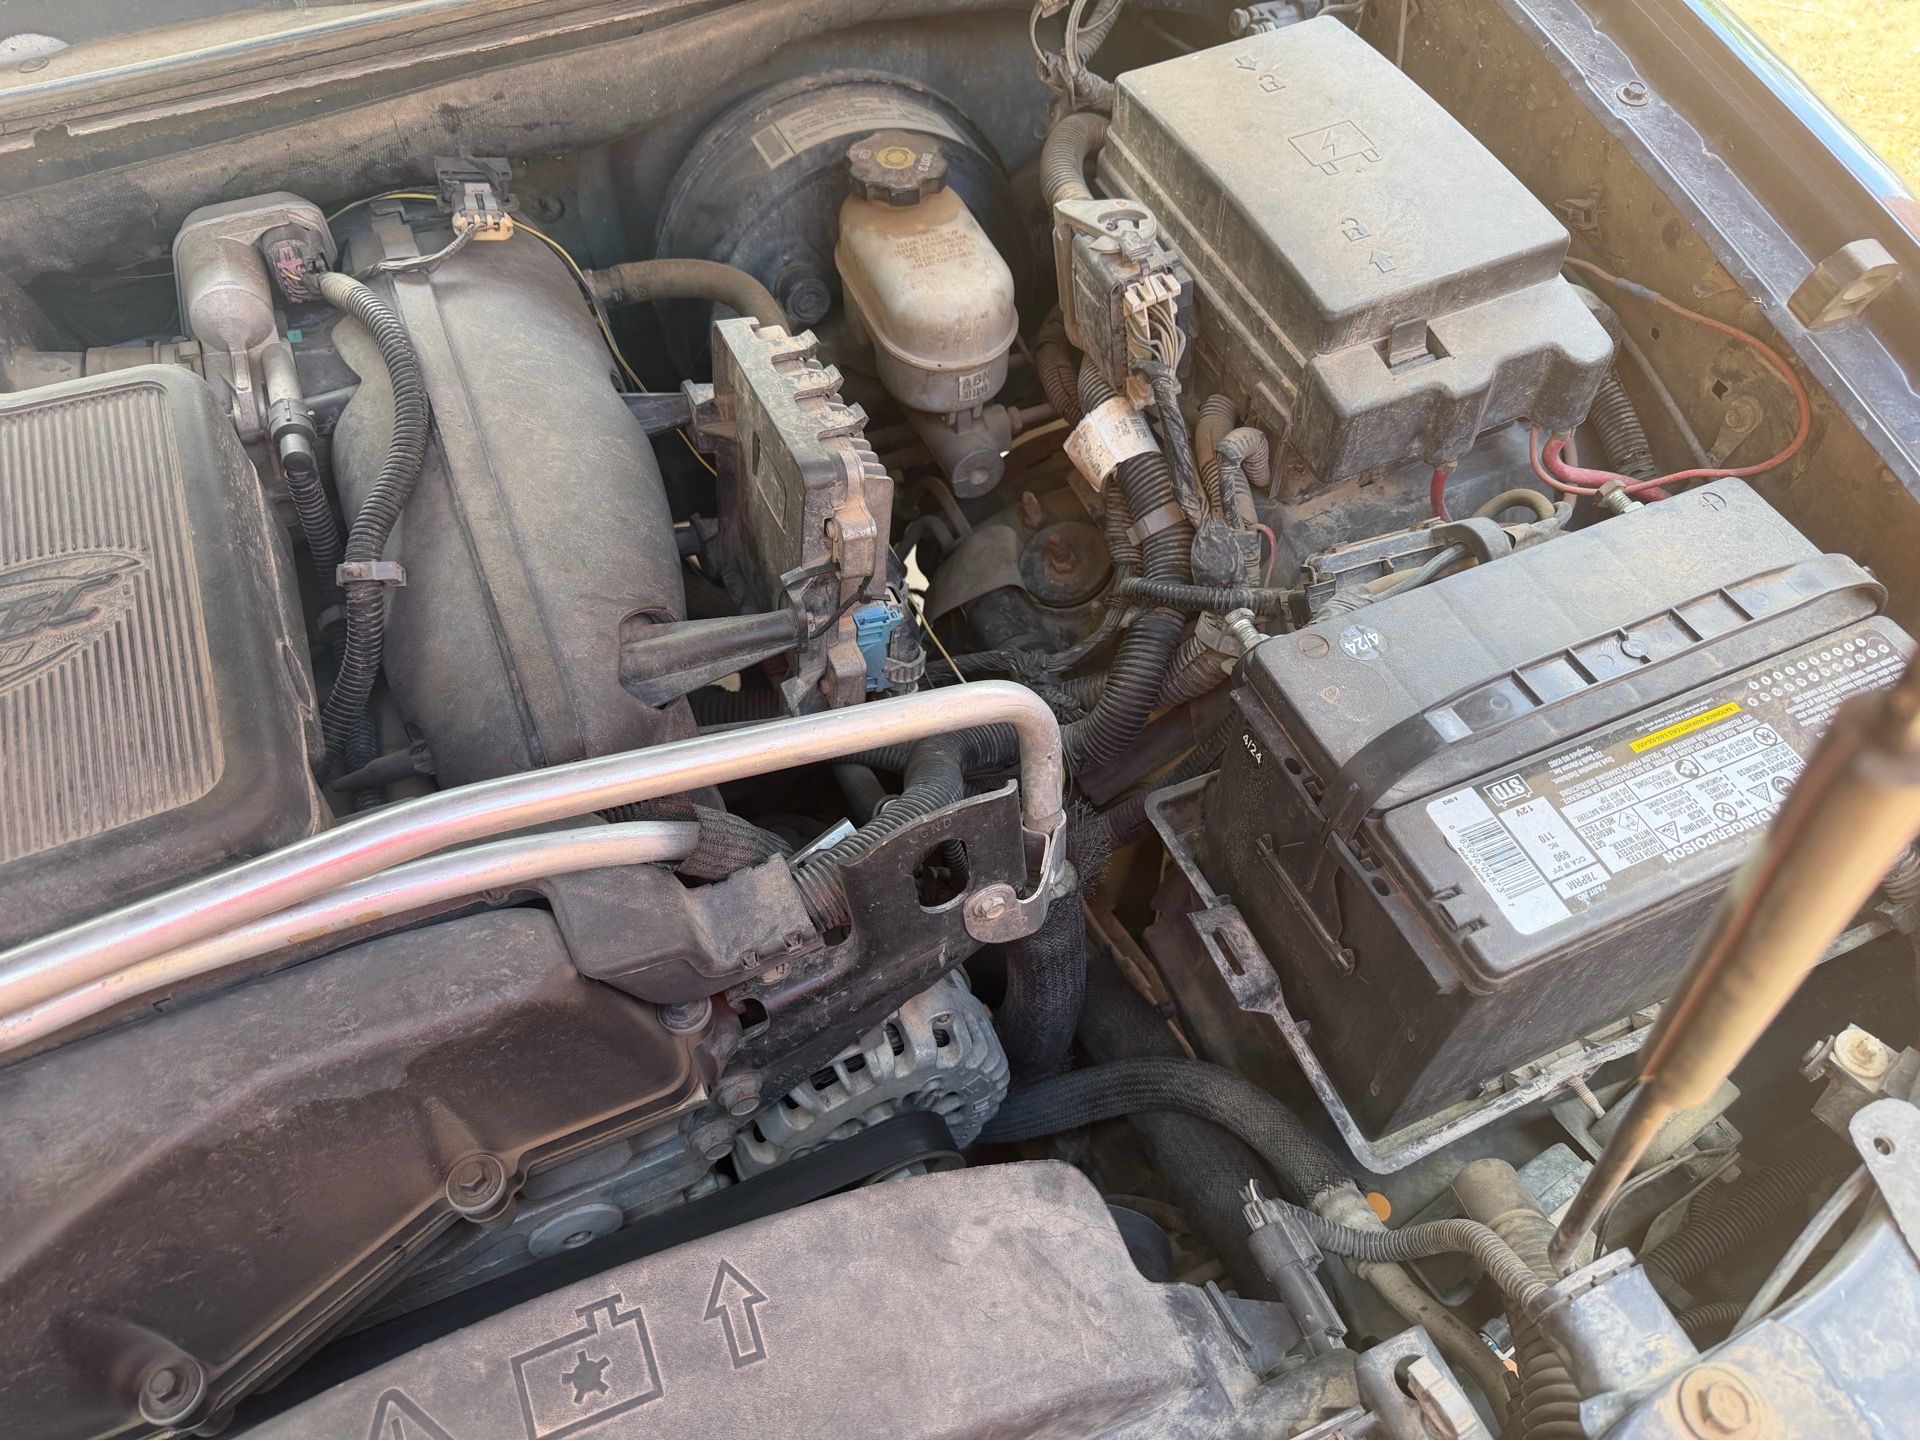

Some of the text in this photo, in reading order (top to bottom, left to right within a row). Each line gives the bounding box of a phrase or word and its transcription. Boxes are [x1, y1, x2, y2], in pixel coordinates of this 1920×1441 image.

[1344, 632, 1379, 655] 4/24
[1704, 706, 1732, 720] NATIONWIDE
[1679, 718, 1704, 730] WARRANTY
[1734, 736, 1752, 746] REACH
[1743, 742, 1757, 750] KEEP
[1242, 734, 1262, 765] 4/24
[1732, 747, 1745, 755] OUT
[1765, 754, 1782, 763] CAUSE
[1736, 761, 1765, 776] BLINDNESS
[1748, 755, 1800, 781] EXPLOSIVE GASES
[1662, 776, 1678, 785] READ
[1492, 780, 1526, 801] STD
[1607, 791, 1620, 799] NOT
[1663, 789, 1685, 800] SEVERE
[1598, 802, 1614, 811] OPEN
[1612, 797, 1625, 805] NOT
[1660, 795, 1691, 810] BLINDNESS
[1734, 799, 1746, 808] NO
[1513, 804, 1533, 816] 12V
[1666, 802, 1697, 818] CAN CAUSE
[1686, 809, 1703, 819] ACID
[1579, 816, 1615, 834] HELP FAST.
[1679, 816, 1711, 833] SULFURIC
[1537, 831, 1554, 842] 110
[1585, 826, 1614, 842] MEDICAL
[1609, 829, 1651, 850] WITH WATER.
[1661, 809, 1772, 862] DANGER/POISON
[1590, 840, 1606, 849] GET
[1614, 836, 1658, 858] IMMEDIATELY
[1552, 850, 1570, 861] 690
[1570, 855, 1586, 864] CCA
[1626, 844, 1664, 863] FLUSH EYES
[1458, 838, 1483, 863] 83996
[1479, 867, 1505, 892] 04873
[1565, 871, 1597, 889] 78PRM
[1588, 884, 1607, 895] PART
